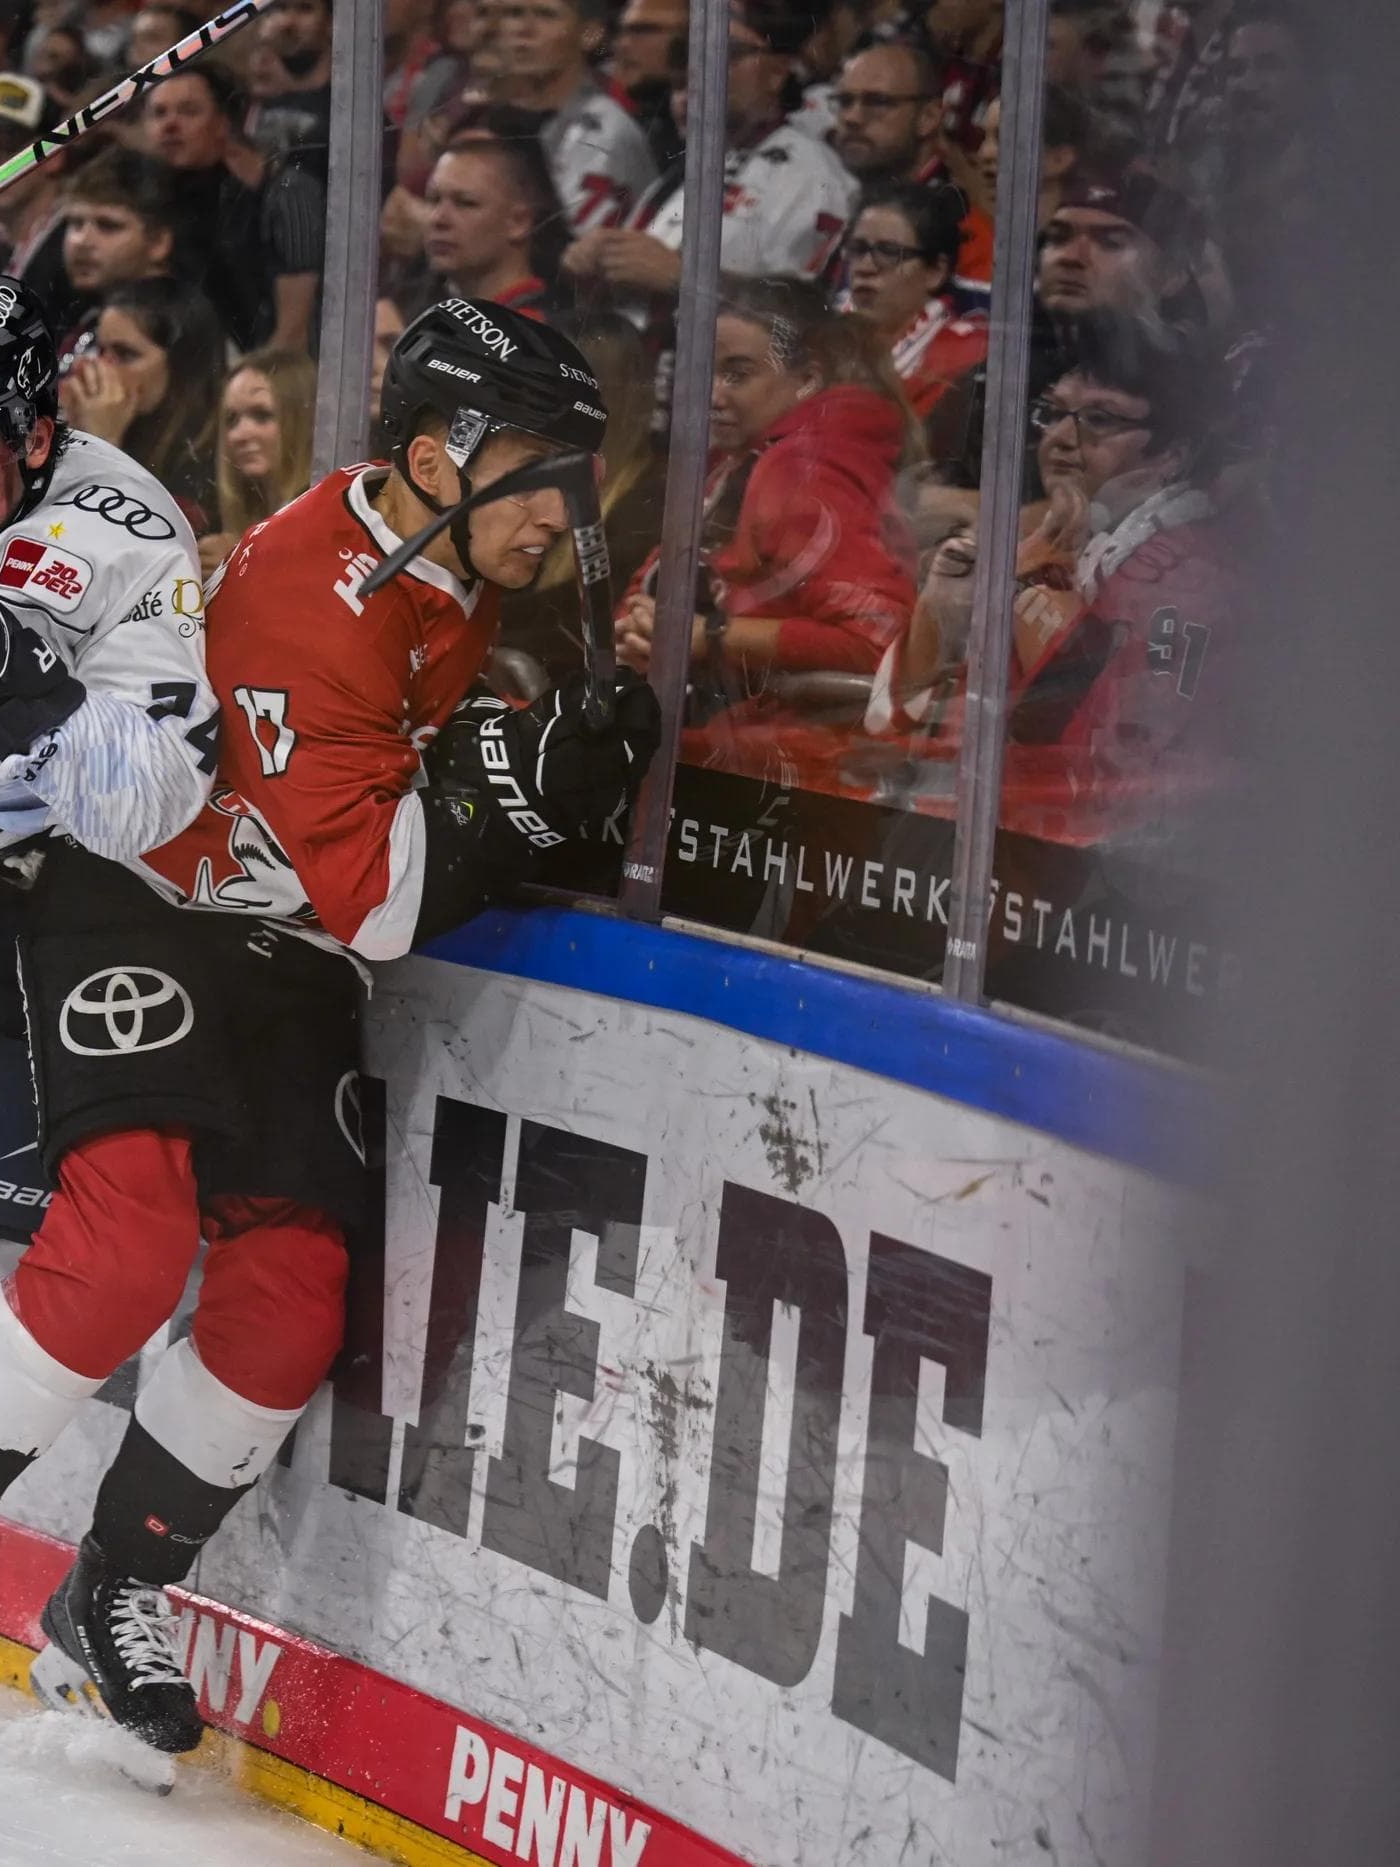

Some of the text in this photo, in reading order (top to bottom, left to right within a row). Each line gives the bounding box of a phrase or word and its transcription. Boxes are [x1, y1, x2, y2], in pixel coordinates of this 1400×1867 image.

[33, 2, 257, 162] NEXUS
[427, 359, 482, 384] BAUER
[438, 298, 518, 362] STETSON
[573, 401, 608, 422] BAUER
[45, 559, 80, 580] 30
[146, 682, 220, 777] 74
[233, 684, 296, 779] 17
[480, 714, 567, 848] BAUER
[1002, 891, 1208, 998] STAHLWE
